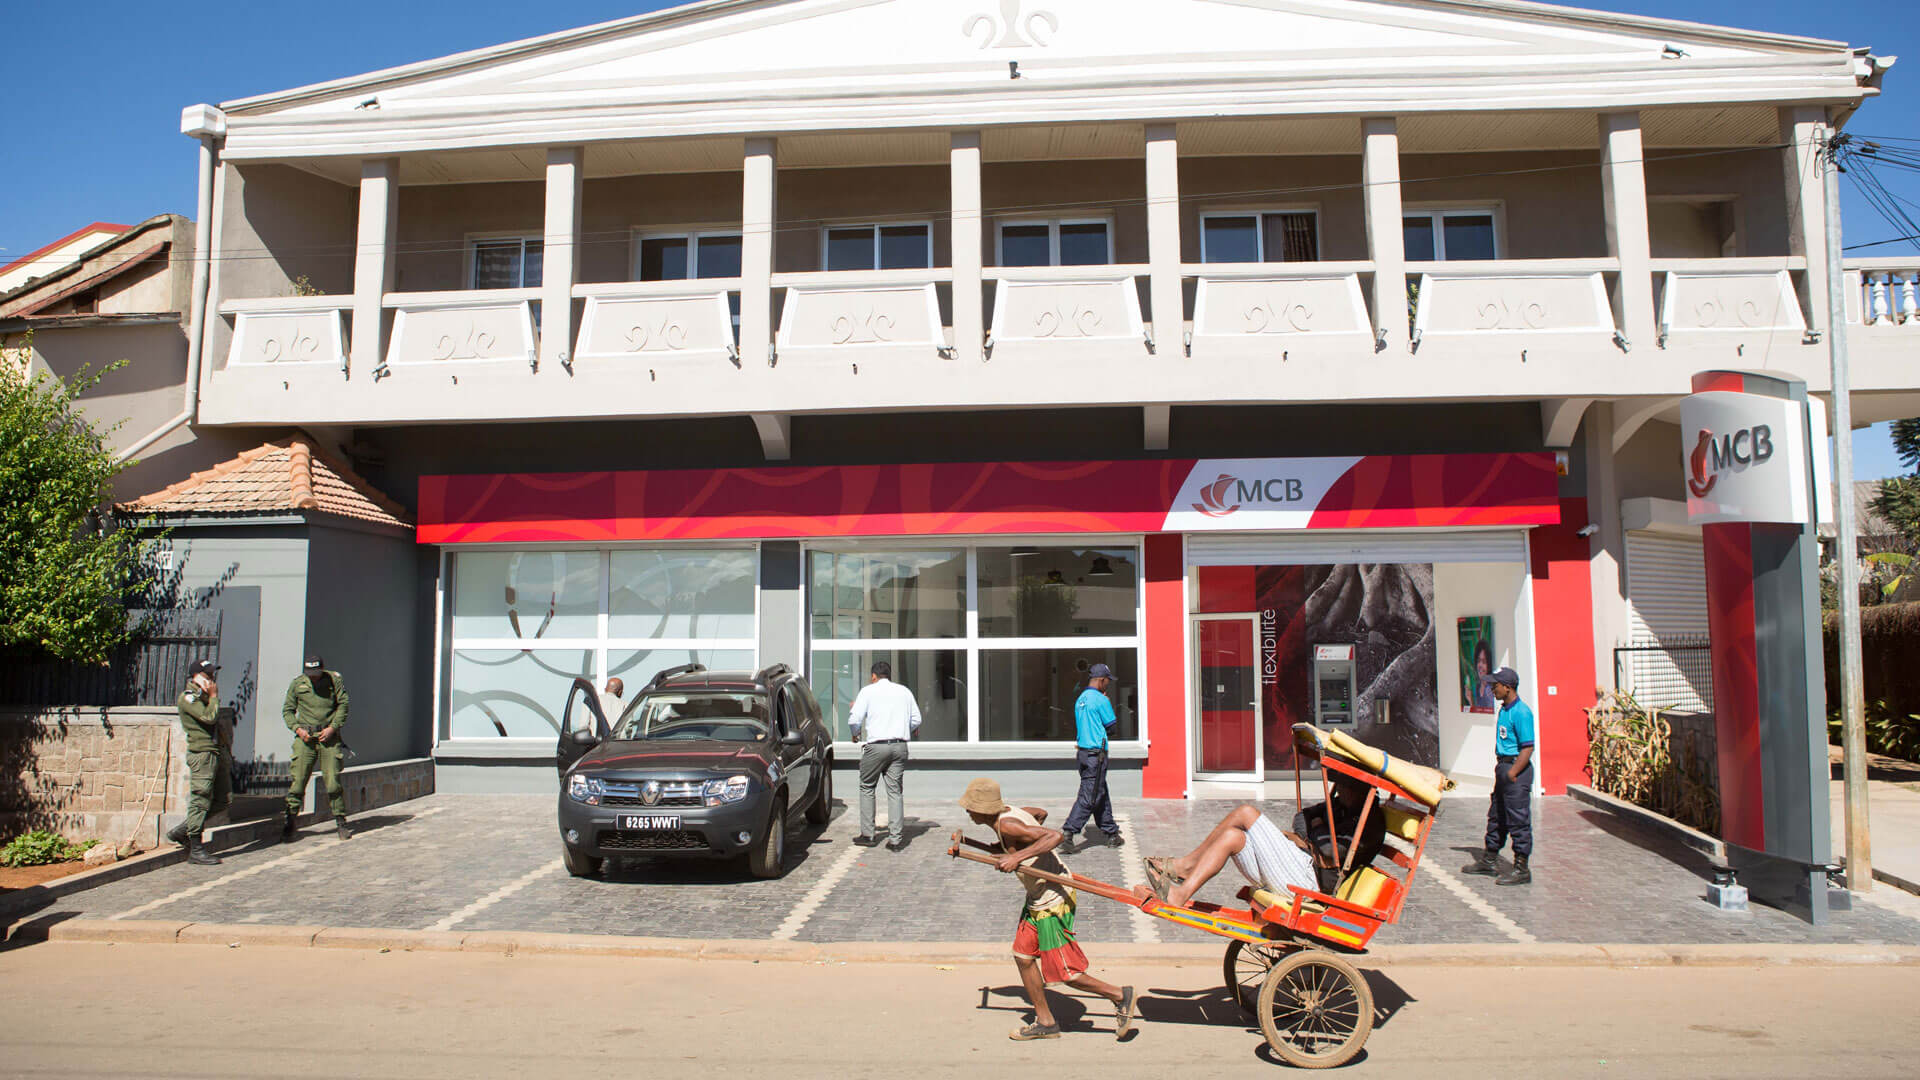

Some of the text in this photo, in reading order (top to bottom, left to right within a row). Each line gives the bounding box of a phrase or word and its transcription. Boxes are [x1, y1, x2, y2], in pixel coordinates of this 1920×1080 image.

[1711, 424, 1774, 472] MCB
[1237, 478, 1304, 503] MCB
[626, 816, 678, 829] 6265 WWT
